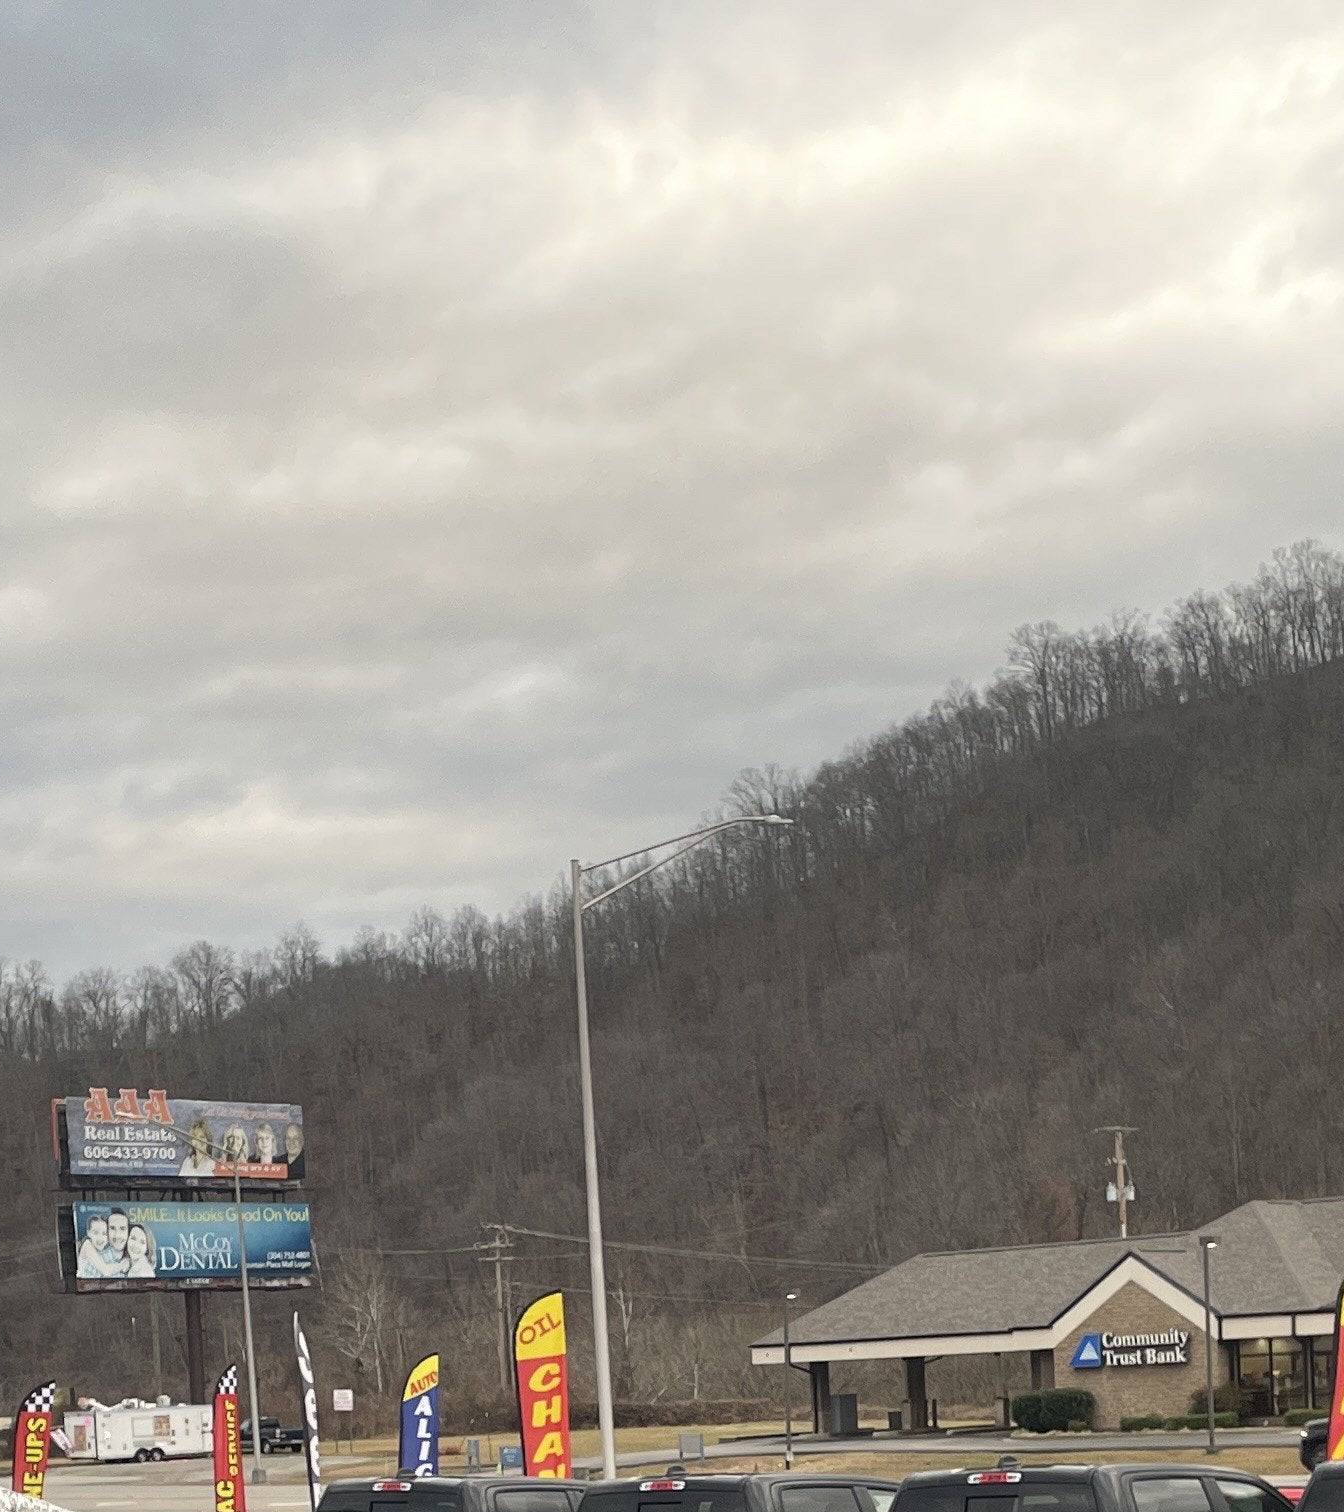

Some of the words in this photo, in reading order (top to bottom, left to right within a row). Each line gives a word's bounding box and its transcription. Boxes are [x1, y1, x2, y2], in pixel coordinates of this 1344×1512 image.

[84, 1087, 174, 1124] AAA
[84, 1126, 120, 1142] Real
[83, 1147, 176, 1160] 606-433-9700
[187, 1208, 224, 1222] Looks
[226, 1207, 260, 1222] God
[263, 1207, 283, 1221] On
[285, 1207, 309, 1222] You!
[159, 1246, 238, 1271] DENTAL
[519, 1312, 561, 1345] OIL
[1102, 1328, 1189, 1348] Community
[1102, 1349, 1142, 1366] Trust
[1146, 1346, 1188, 1365] Bank
[410, 1371, 438, 1396] AUTO
